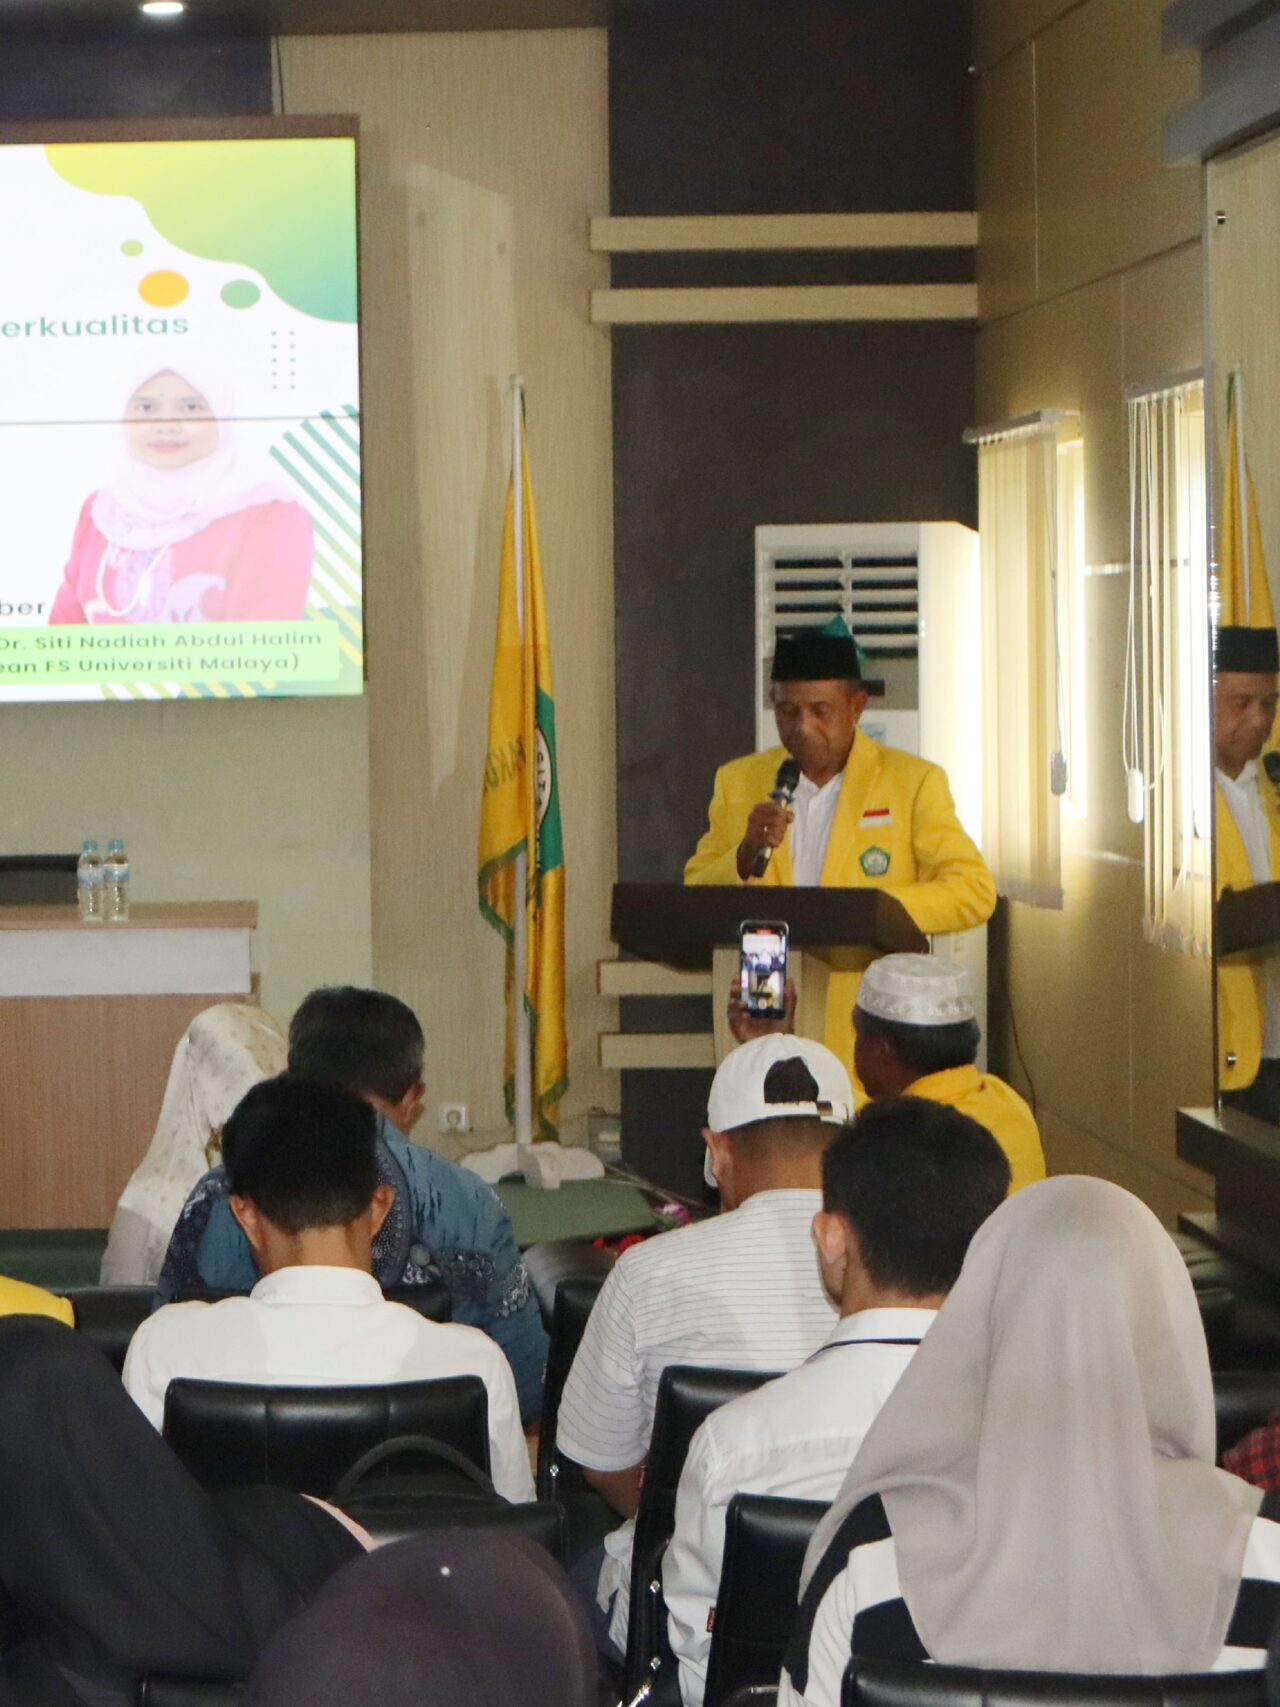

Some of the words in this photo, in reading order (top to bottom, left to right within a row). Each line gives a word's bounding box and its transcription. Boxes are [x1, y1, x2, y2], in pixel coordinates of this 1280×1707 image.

[36, 636, 71, 649] Siti
[80, 634, 165, 648] Nadiah
[175, 633, 244, 647] Abdul
[252, 632, 321, 646] Halim
[47, 659, 71, 672] FS
[79, 657, 192, 672] Universiti
[200, 653, 299, 672] Malaya)
